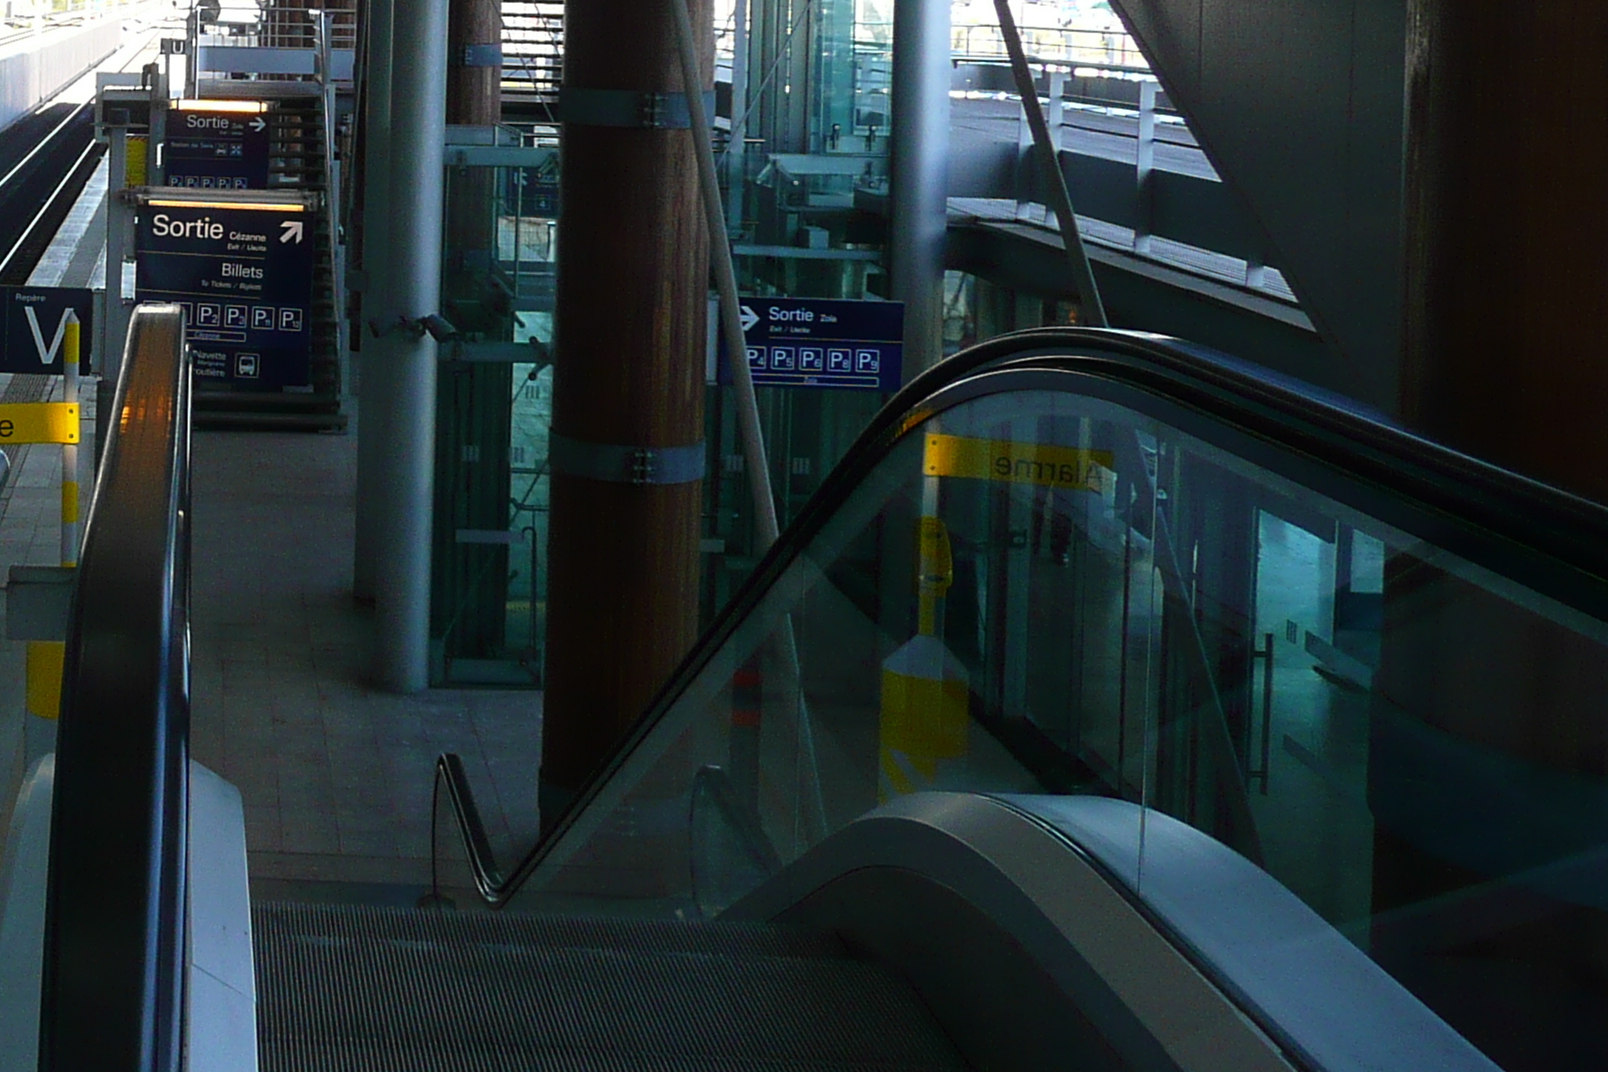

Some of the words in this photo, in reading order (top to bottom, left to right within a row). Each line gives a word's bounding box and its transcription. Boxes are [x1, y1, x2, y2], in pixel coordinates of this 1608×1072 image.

[173, 41, 183, 54] U
[186, 114, 229, 129] Sortie
[152, 214, 224, 240] Sortie
[229, 231, 267, 242] Cézanne
[221, 262, 264, 279] Billets
[15, 293, 47, 303] Repère
[768, 306, 815, 322] Sortie
[24, 306, 74, 365] V
